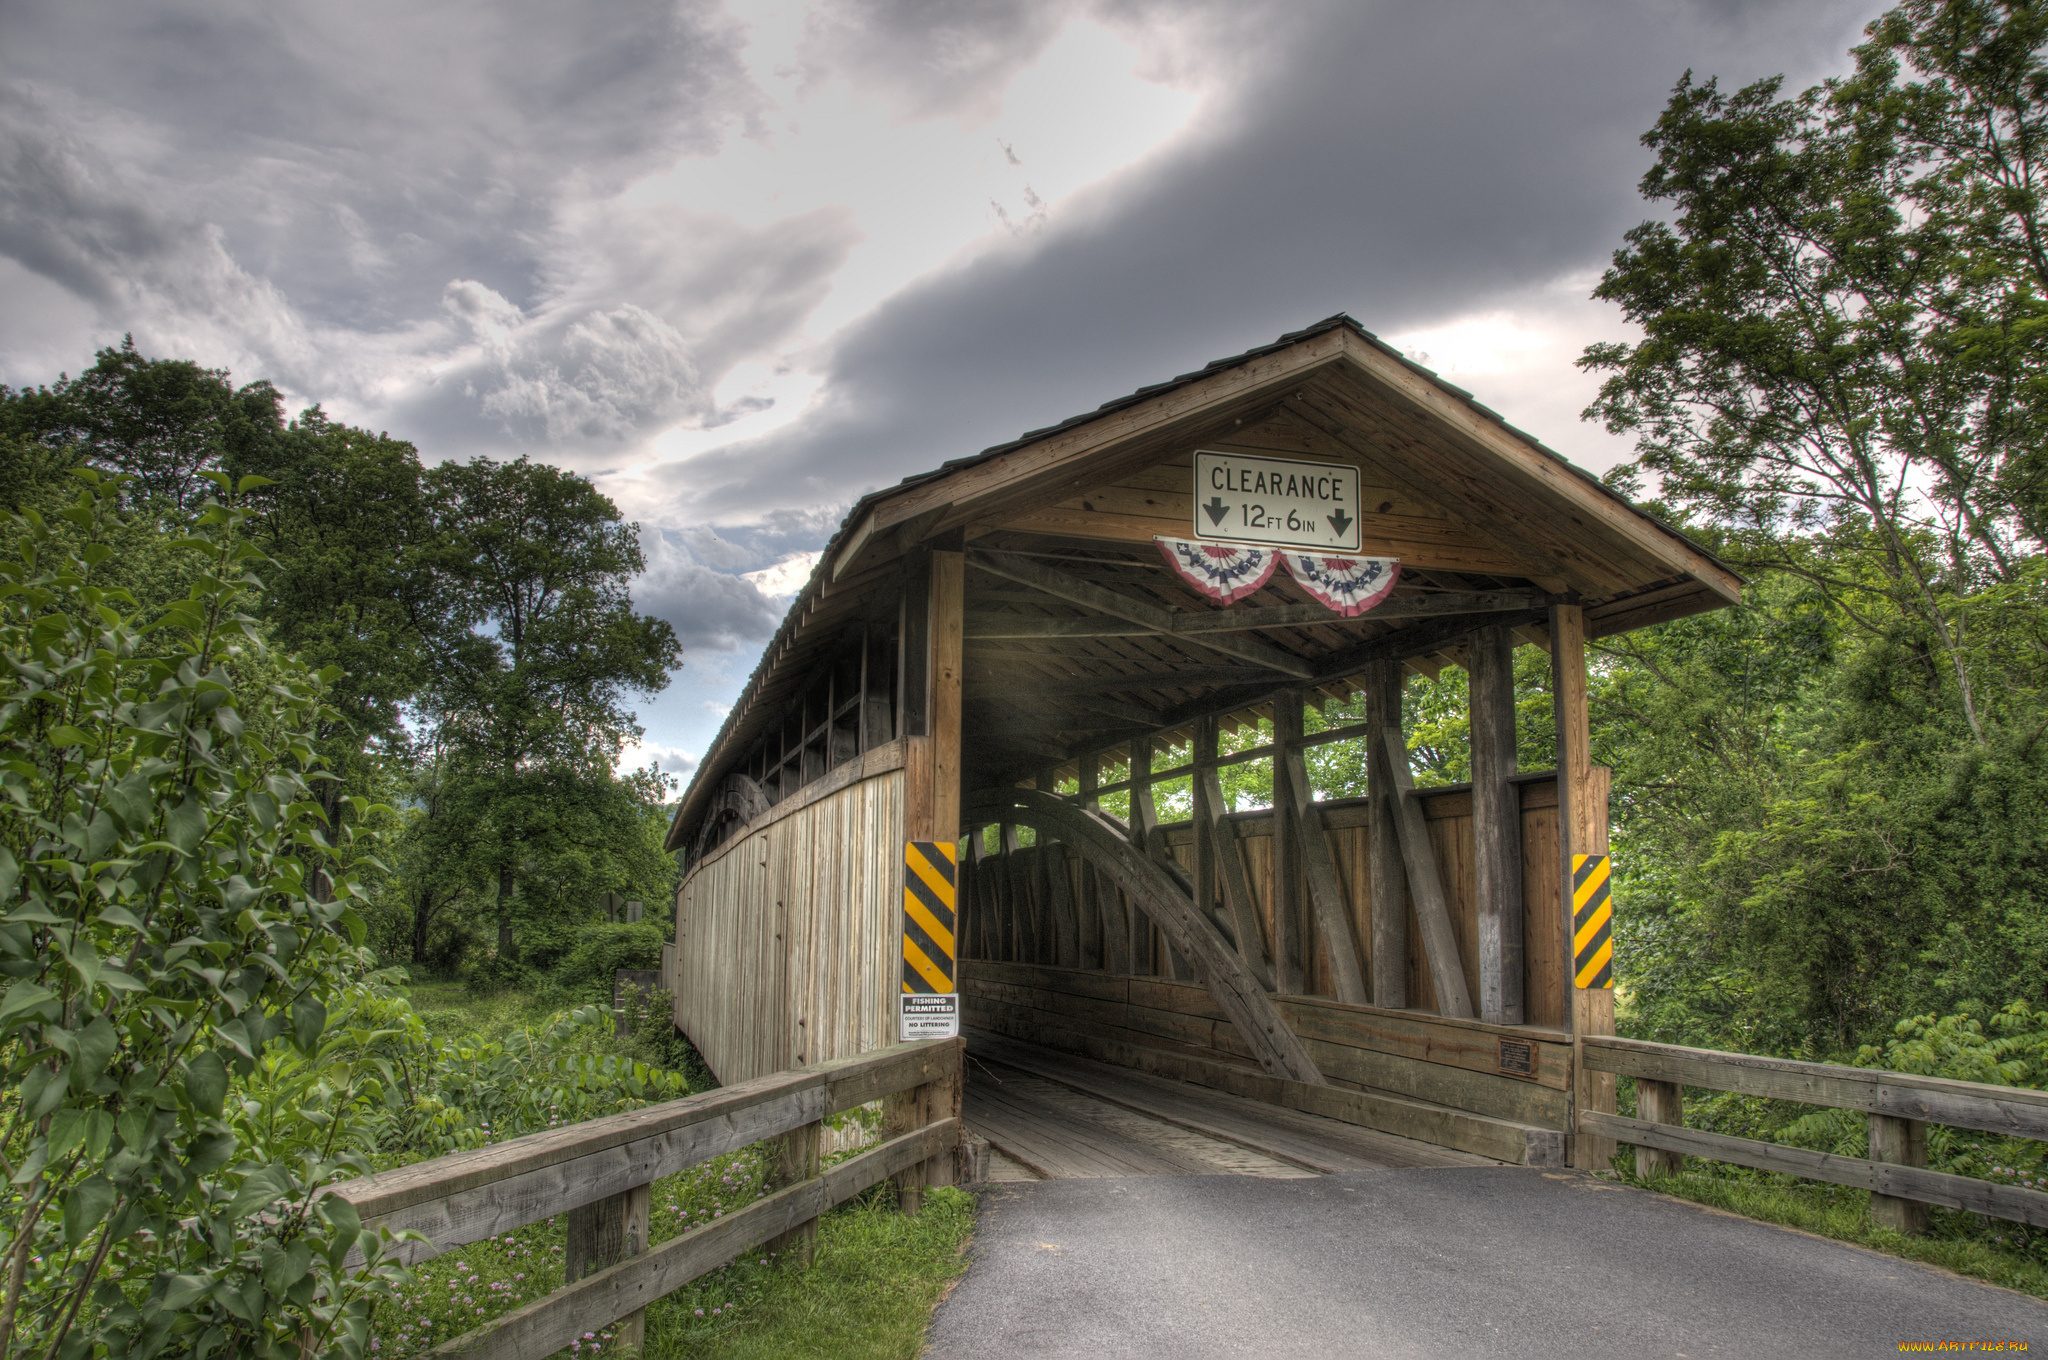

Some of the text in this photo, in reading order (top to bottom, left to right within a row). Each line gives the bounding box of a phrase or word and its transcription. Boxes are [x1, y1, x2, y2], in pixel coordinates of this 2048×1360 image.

[1211, 466, 1344, 501] CLEARANCE
[1242, 504, 1315, 532] 12FT 6IN
